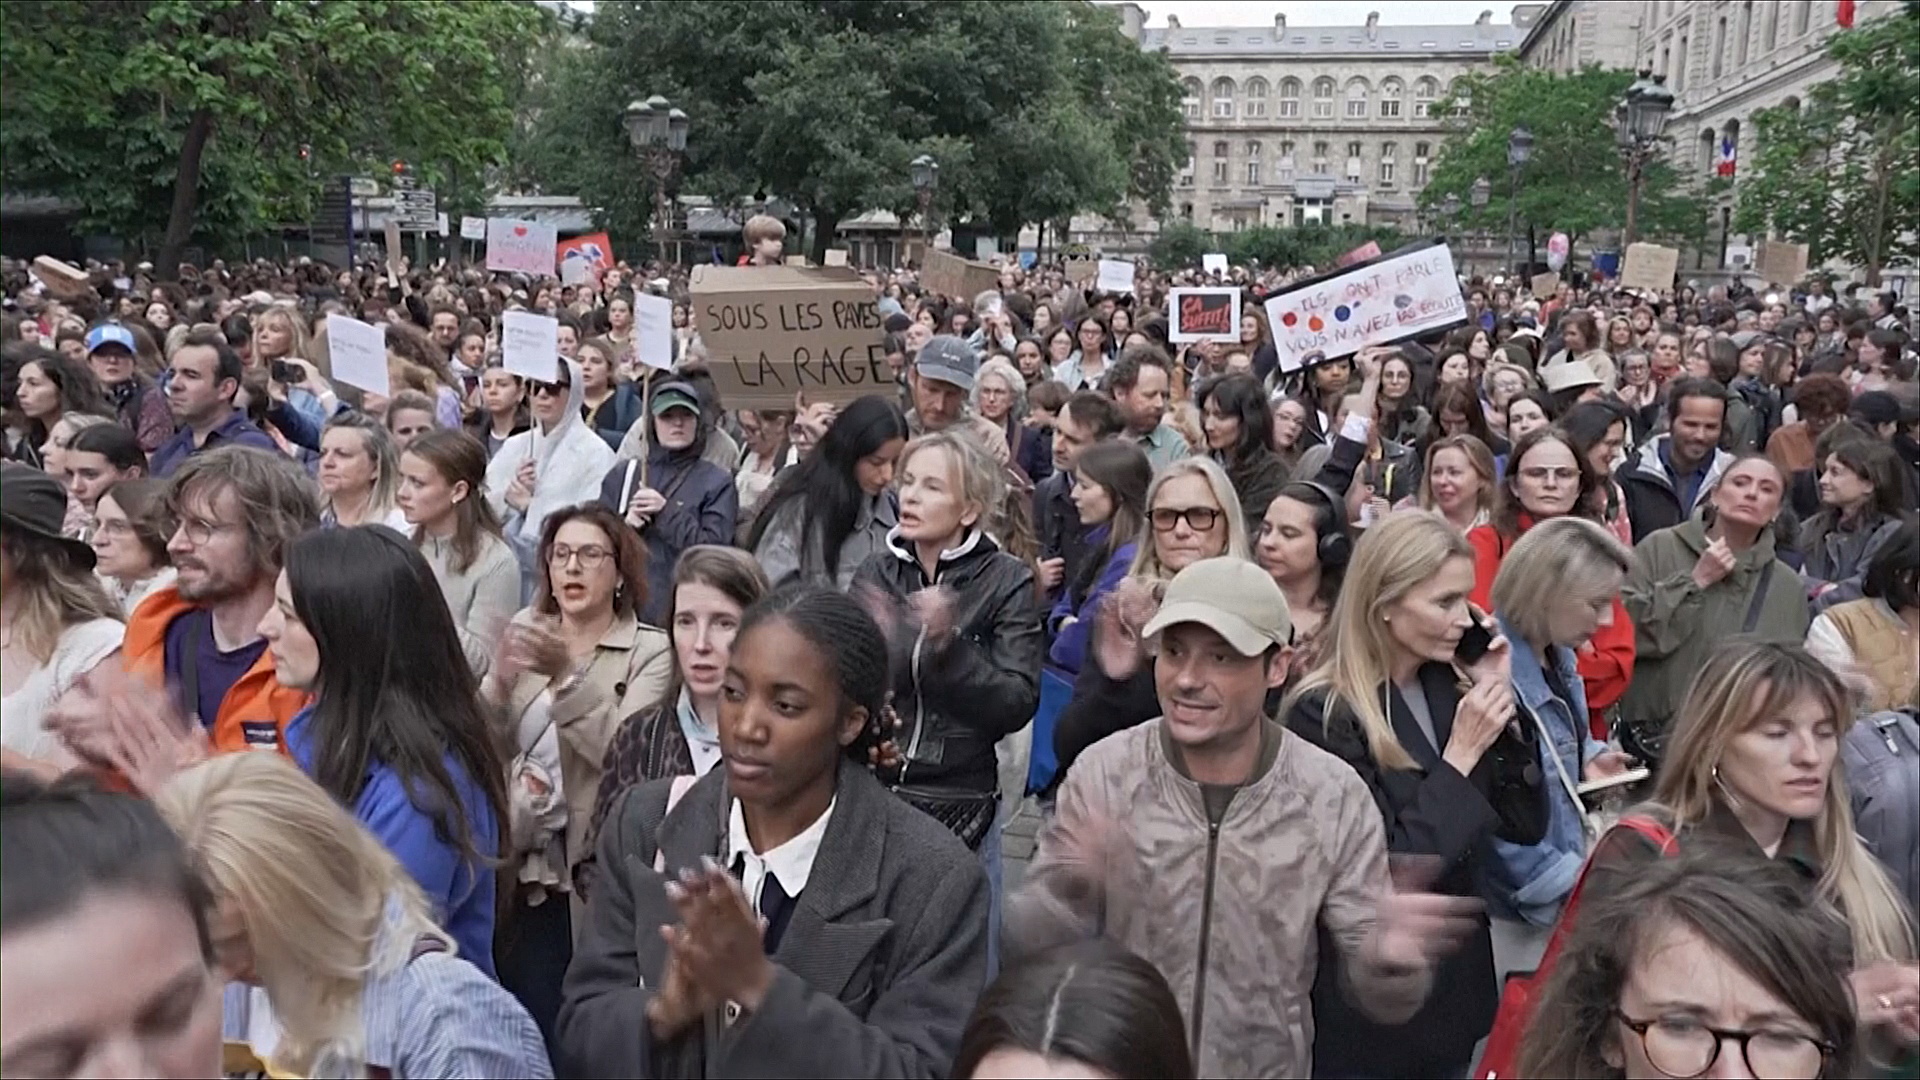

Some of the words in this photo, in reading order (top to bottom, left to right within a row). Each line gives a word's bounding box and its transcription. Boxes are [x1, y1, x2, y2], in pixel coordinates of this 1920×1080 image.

[1300, 291, 1328, 313] ILS
[1346, 274, 1381, 298] ONT
[706, 303, 768, 332] SOUS
[779, 302, 823, 332] LES
[833, 300, 882, 330] PAVES
[1285, 331, 1328, 354] VOUS
[732, 351, 786, 388] LA
[793, 344, 895, 386] RAGE
